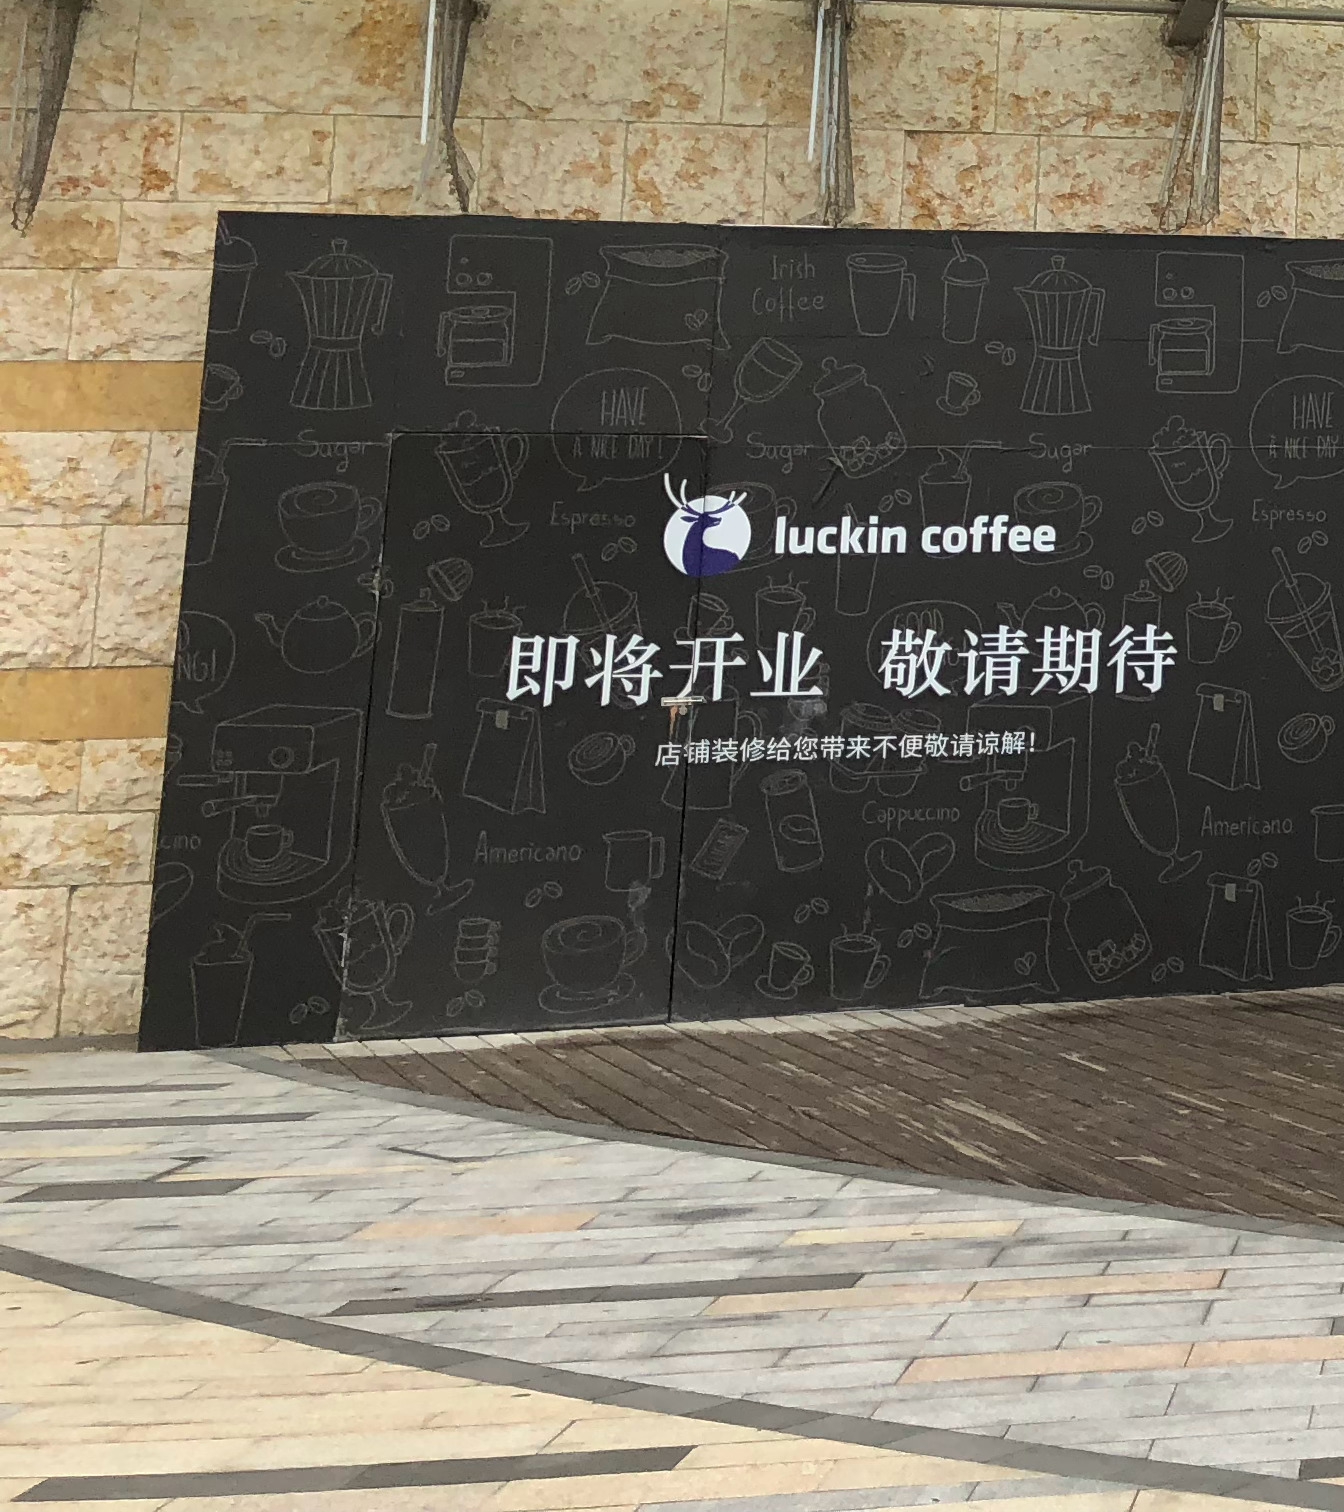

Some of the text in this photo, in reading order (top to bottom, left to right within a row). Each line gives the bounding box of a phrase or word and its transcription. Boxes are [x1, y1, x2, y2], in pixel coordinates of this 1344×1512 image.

[771, 254, 817, 279] Irish
[751, 287, 825, 322] Coffee
[600, 387, 649, 426] HAVE
[1292, 392, 1335, 430] HAVE
[550, 501, 636, 534] Espresso
[1251, 499, 1327, 530] Espresso
[775, 513, 1057, 555] luckin coffee
[503, 623, 1179, 709] 即将开业 敬请期待
[655, 729, 1037, 768] 店铺装修给您带来不便敬请谅解!
[861, 801, 961, 831] Cappuccino
[1200, 805, 1294, 838] Americano
[473, 831, 582, 865] Americano
